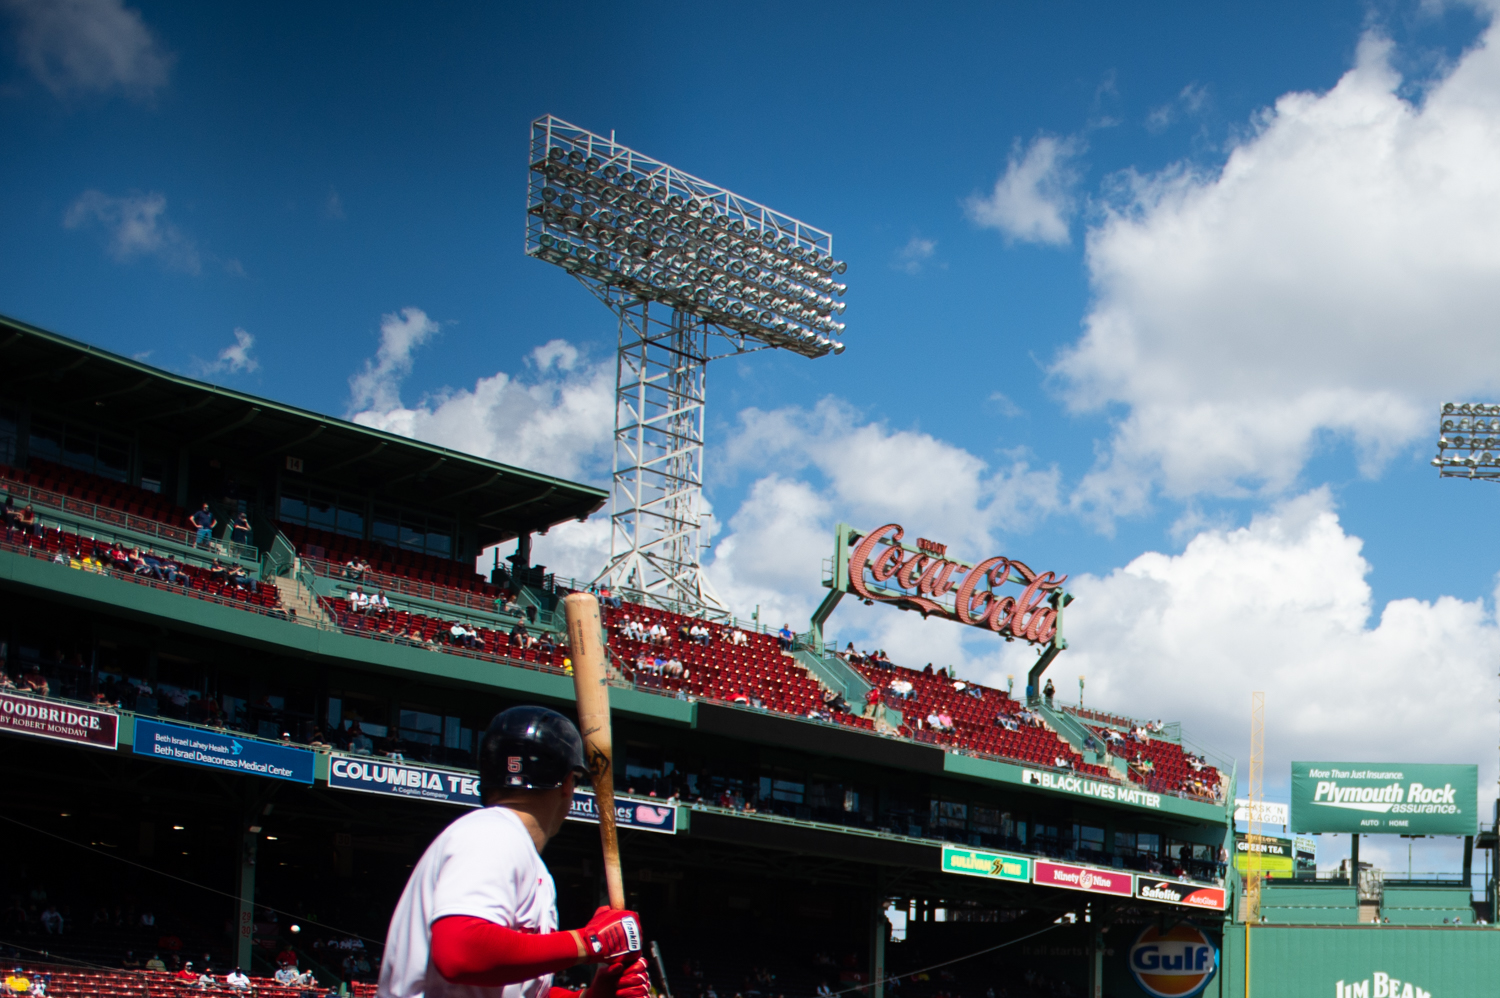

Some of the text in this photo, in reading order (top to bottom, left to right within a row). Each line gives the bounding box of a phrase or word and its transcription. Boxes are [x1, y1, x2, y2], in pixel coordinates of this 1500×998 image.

[849, 523, 1068, 643] Coca-Cola
[0, 700, 100, 730] OODBRIDGE
[13, 717, 88, 738] ROBERT MONDAVI
[155, 732, 229, 754] Beth Israel Lahey Health
[154, 743, 293, 777] Beth Israel Deaconess Medical Center
[507, 756, 522, 772] 5
[332, 760, 443, 791] COLUMBIA
[1309, 769, 1330, 778] More
[1331, 769, 1349, 779] Than
[1350, 770, 1365, 779] Just
[398, 787, 421, 795] Coghlin
[421, 789, 449, 799] Company
[1042, 774, 1160, 808] BLACK LIVES MATTER
[1314, 781, 1456, 803] Plymouth Rock
[1245, 803, 1270, 812] CASK
[1392, 803, 1456, 814] assurance
[1245, 812, 1286, 824] FLAGON
[1360, 819, 1380, 827] AUTO
[1237, 842, 1284, 854] GREEN TEA
[950, 854, 1021, 876] SULLIVAN TIRE
[1054, 870, 1111, 887] Ninety Nine
[1142, 886, 1218, 907] Safelite AutoGlass
[242, 911, 251, 921] 29
[1033, 945, 1082, 956] all starts
[1133, 946, 1209, 970] Gulf
